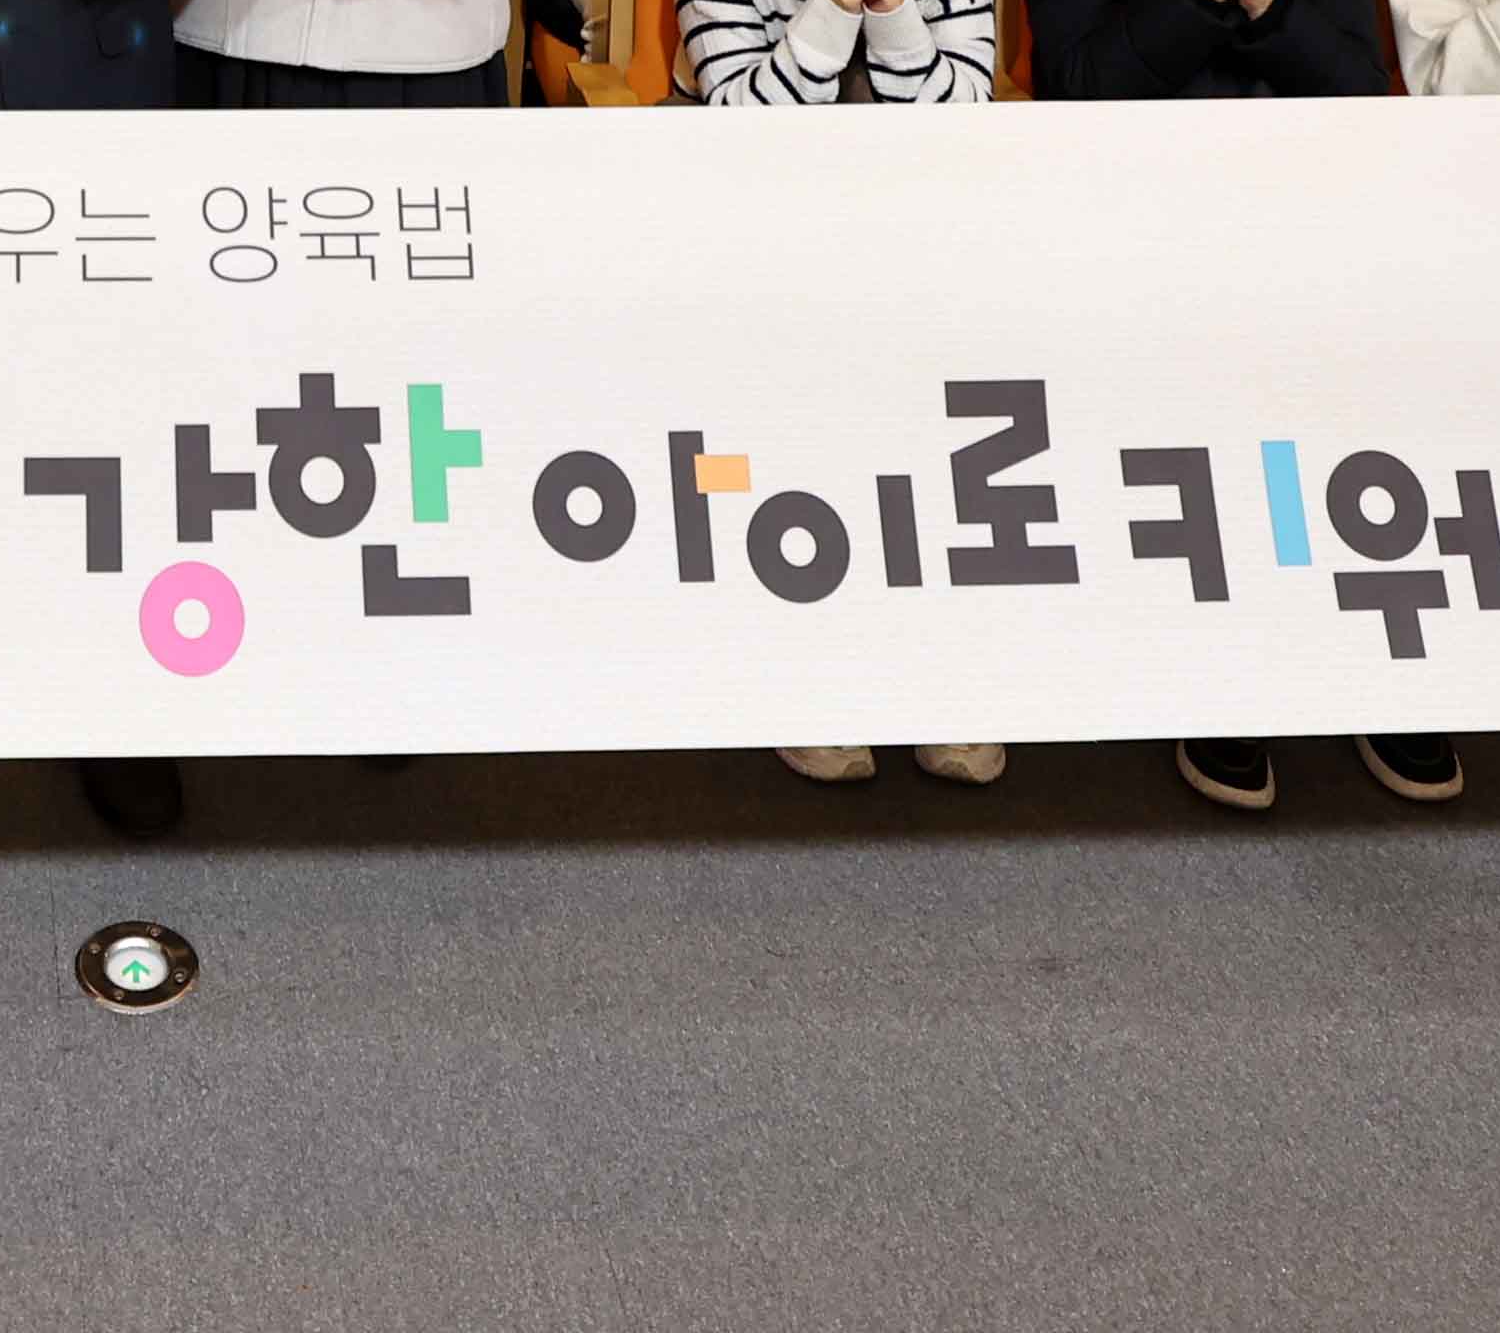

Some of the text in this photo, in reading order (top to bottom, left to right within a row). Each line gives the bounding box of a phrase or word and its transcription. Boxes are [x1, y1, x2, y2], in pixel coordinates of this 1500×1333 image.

[203, 187, 473, 282] 양육법
[24, 373, 481, 676] 강한
[533, 380, 1079, 603] 아이로
